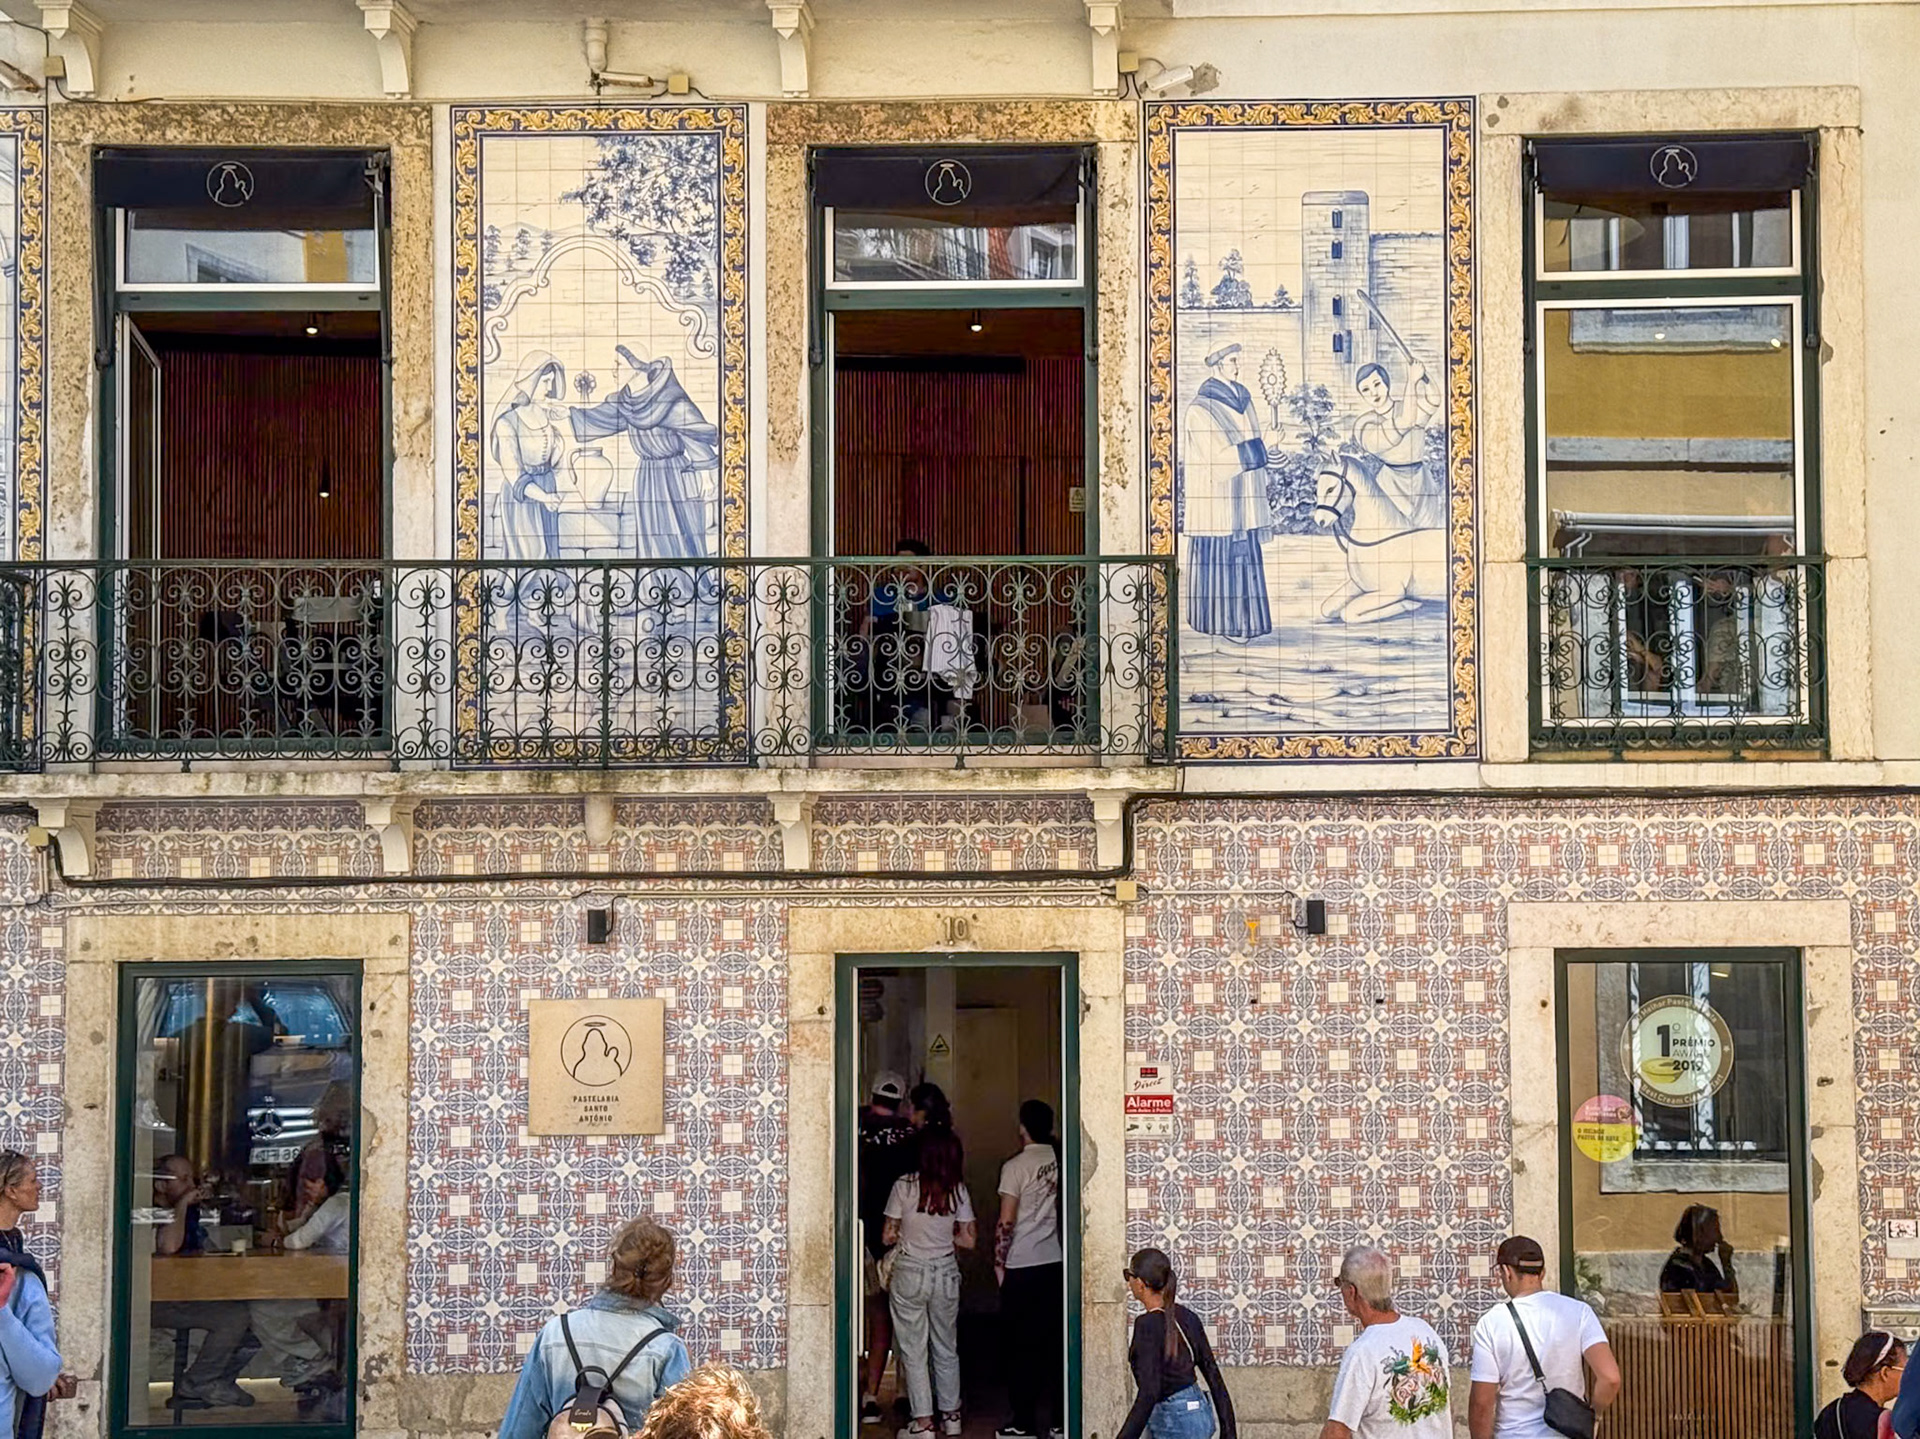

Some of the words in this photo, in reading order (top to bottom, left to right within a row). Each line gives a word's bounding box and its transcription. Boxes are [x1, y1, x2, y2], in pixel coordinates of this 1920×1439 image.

[943, 916, 968, 941] 10
[1640, 1001, 1666, 1015] Melhor
[1672, 1060, 1703, 1071] 2019
[573, 1095, 619, 1103] PASTELARIA
[1641, 1085, 1657, 1099] Best
[1657, 1095, 1683, 1104] Cream
[1127, 1096, 1171, 1107] Alarme
[579, 1114, 613, 1122] ANTÓNIO
